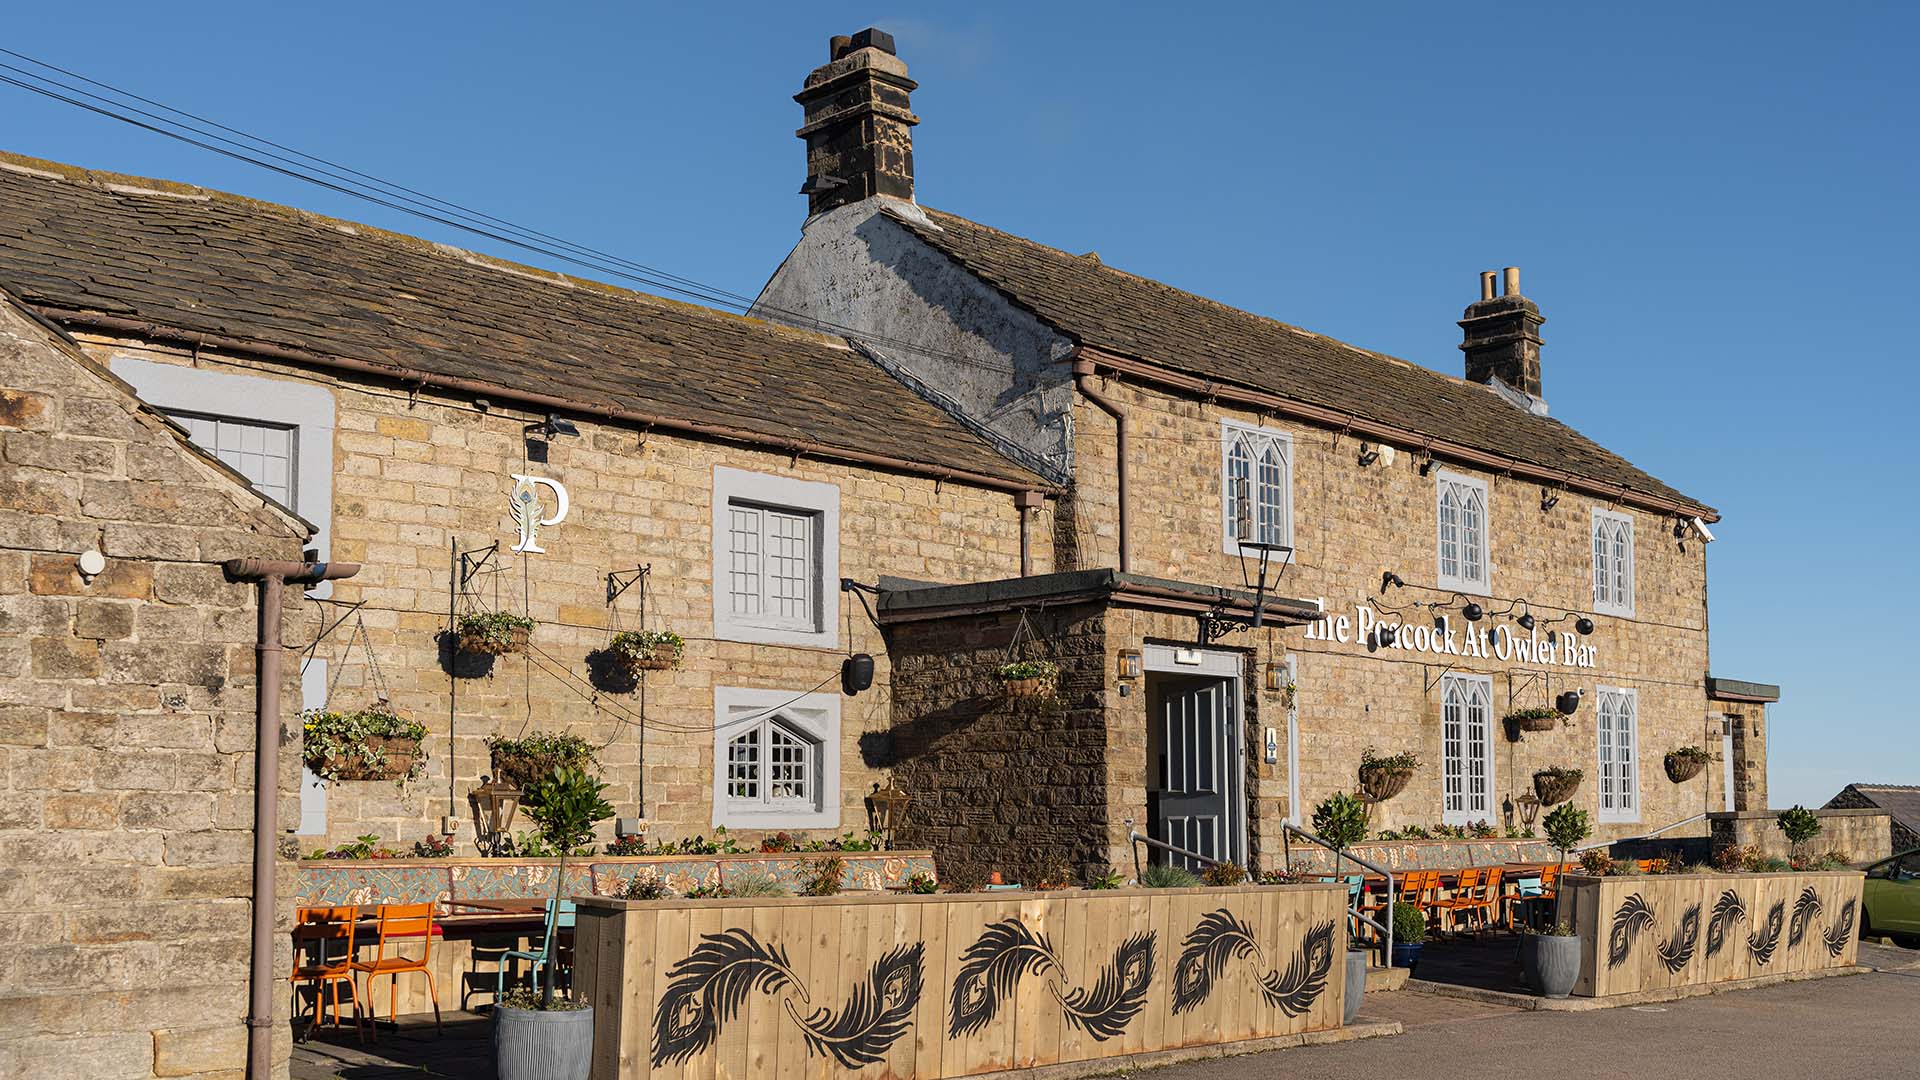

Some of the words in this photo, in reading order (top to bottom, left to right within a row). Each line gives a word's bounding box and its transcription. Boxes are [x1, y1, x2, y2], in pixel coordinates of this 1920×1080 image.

[508, 473, 569, 554] P
[1461, 621, 1490, 660] At
[1493, 624, 1558, 665] Owler
[1561, 632, 1597, 668] Bar
